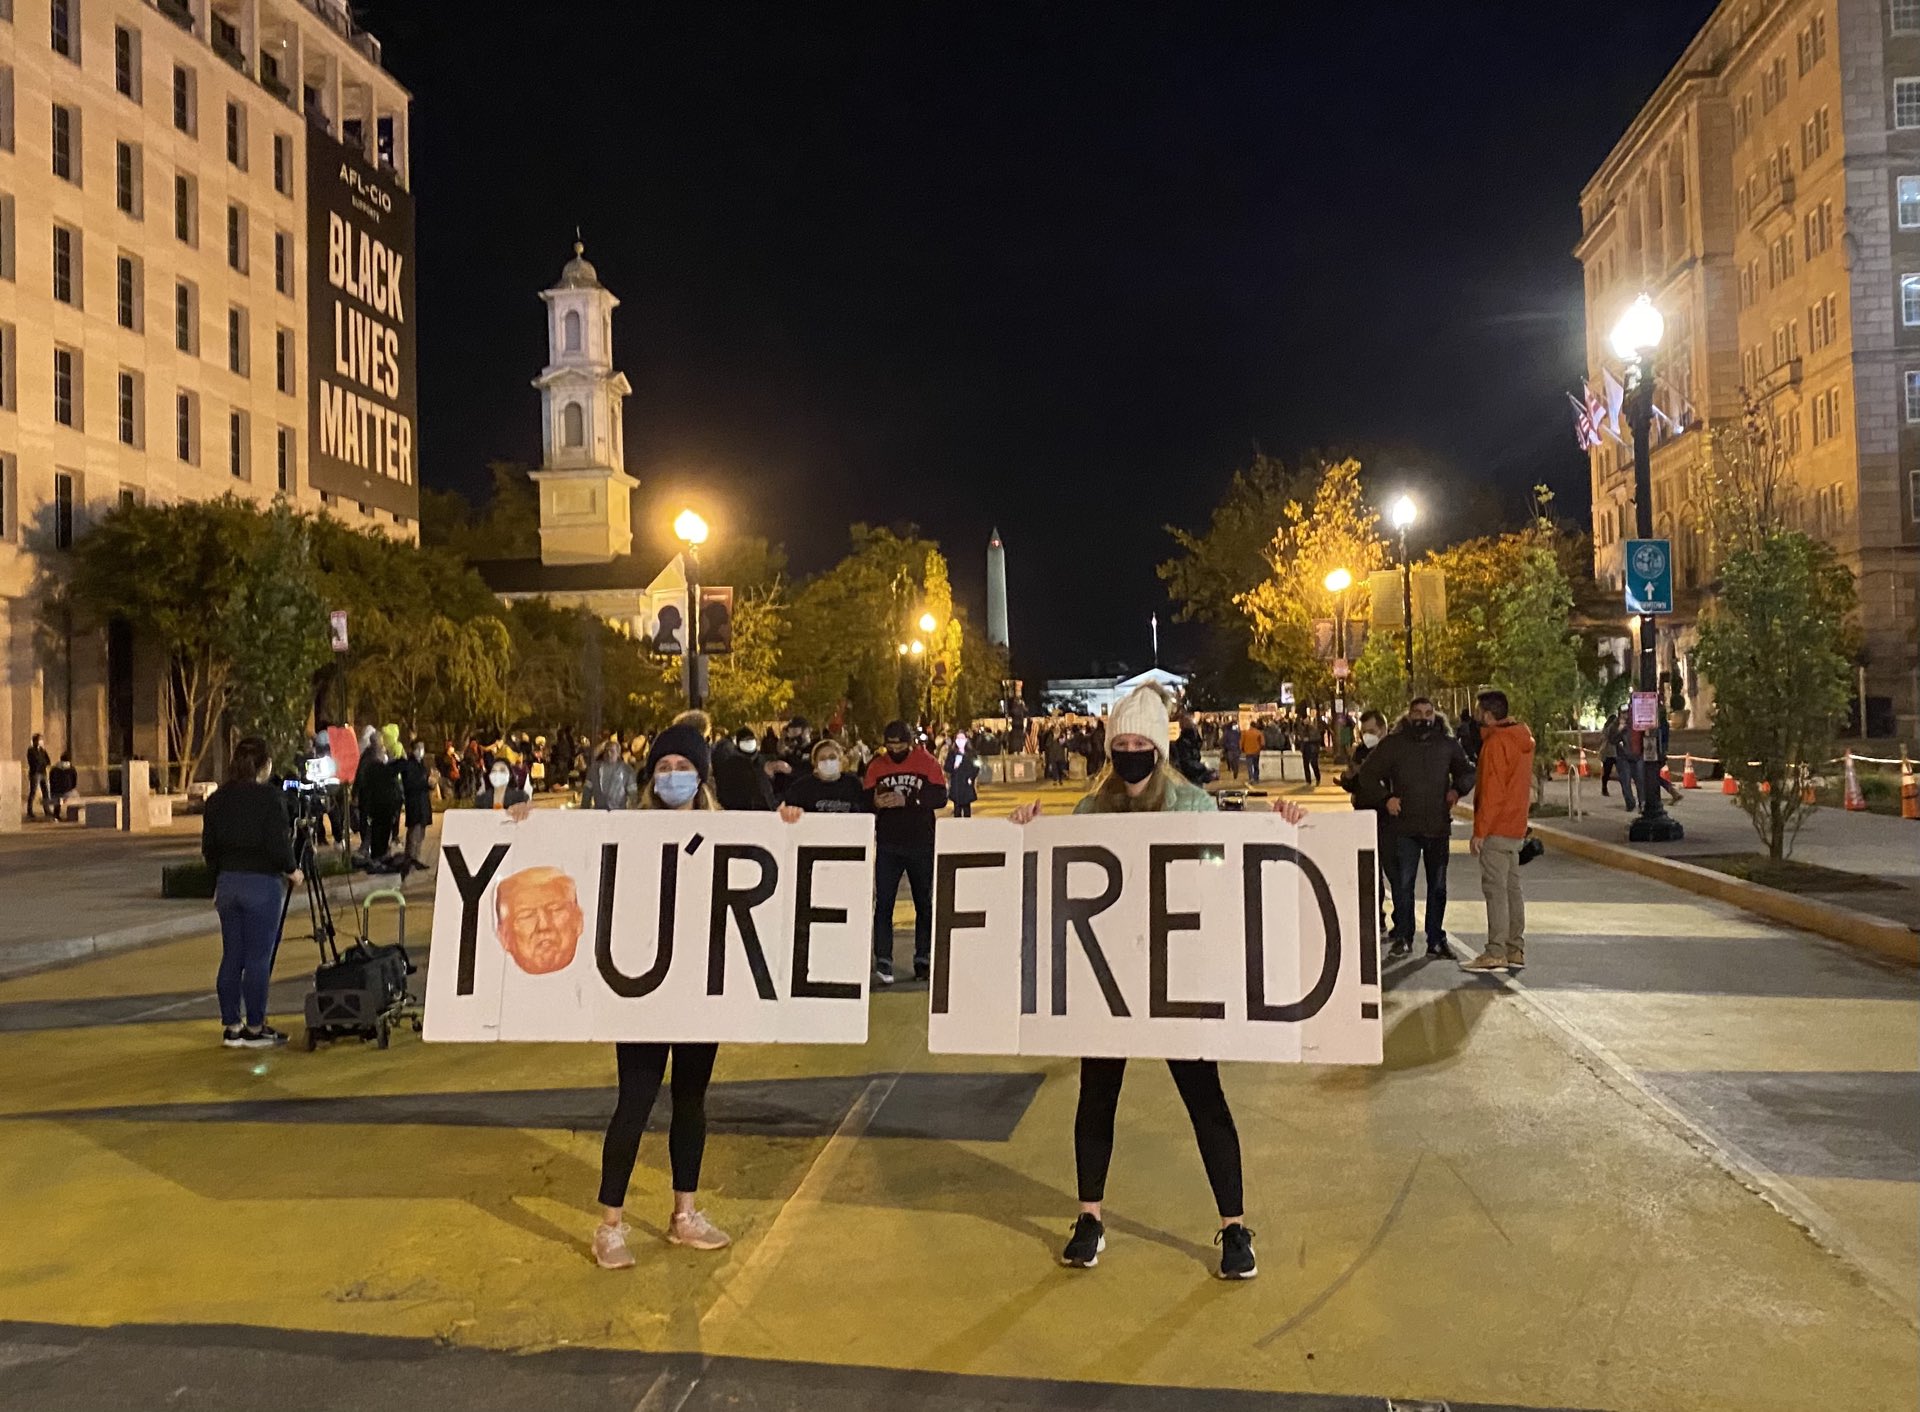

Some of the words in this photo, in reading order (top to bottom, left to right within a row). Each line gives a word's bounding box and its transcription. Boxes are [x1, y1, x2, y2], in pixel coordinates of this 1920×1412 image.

[339, 162, 392, 213] AFL-CIO
[329, 210, 404, 323] BLACK
[335, 300, 399, 400] LIVES
[320, 378, 412, 486] MATTER
[879, 774, 924, 790] TARTER
[443, 833, 867, 1000] YU'RE
[931, 843, 1379, 1022] FIRED!
